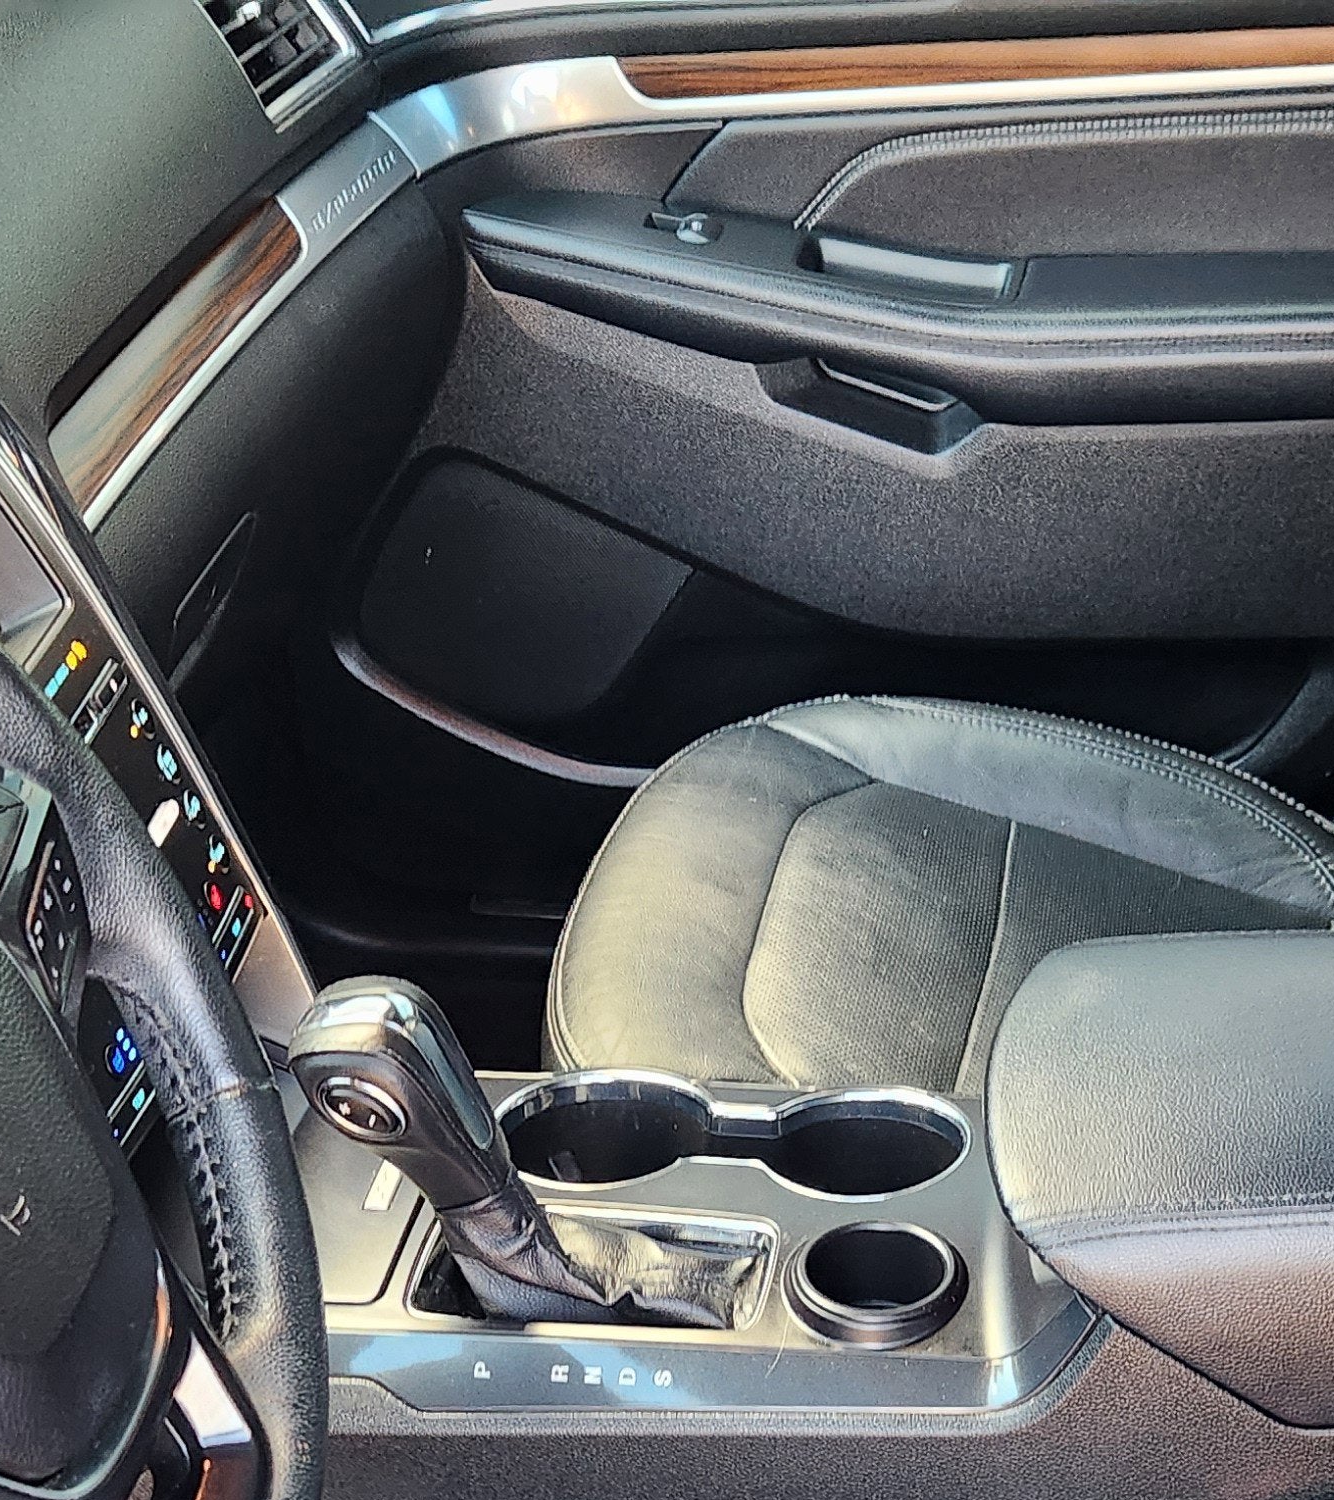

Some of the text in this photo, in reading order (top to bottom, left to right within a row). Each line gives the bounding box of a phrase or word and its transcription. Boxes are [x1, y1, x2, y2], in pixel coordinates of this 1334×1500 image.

[473, 1361, 673, 1388] P R N D S
